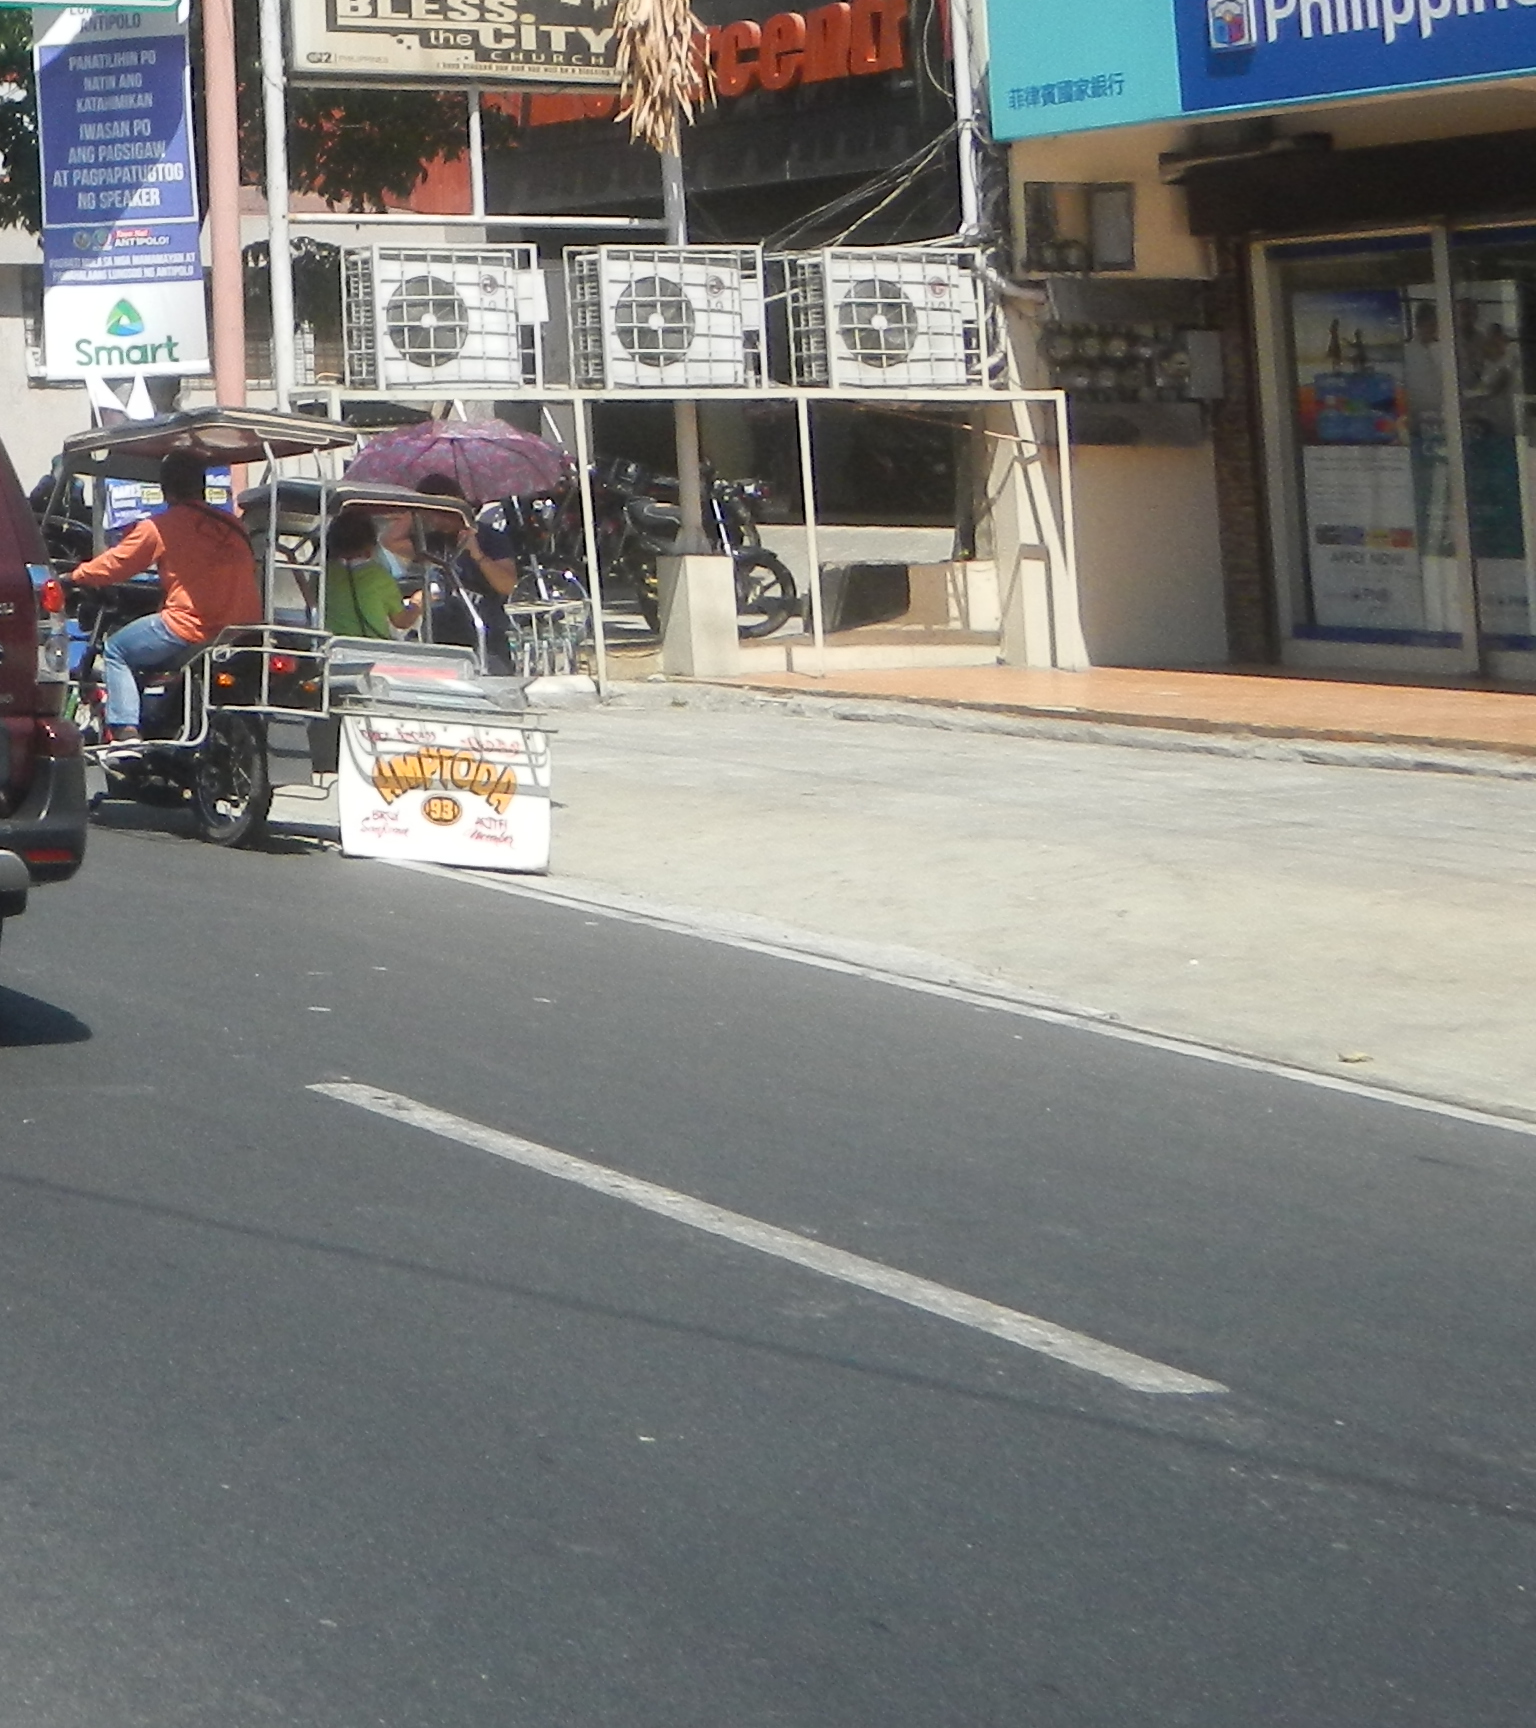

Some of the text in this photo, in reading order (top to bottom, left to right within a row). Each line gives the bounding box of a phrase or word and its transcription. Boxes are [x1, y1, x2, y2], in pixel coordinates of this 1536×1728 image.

[79, 12, 141, 34] ANTIPOLO
[430, 29, 474, 47] the
[141, 50, 157, 66] PO
[490, 51, 605, 66] CHURCH
[83, 73, 142, 91] NATIN ANG
[79, 119, 151, 141] IWASAN PO
[68, 145, 95, 164] ANG
[53, 162, 184, 187] AT PAGPAPATUGTOG
[78, 187, 161, 210] NG SPEAKER
[114, 236, 170, 248] ANTIPOLO!
[75, 335, 180, 366] Smart
[429, 798, 455, 821] 93
